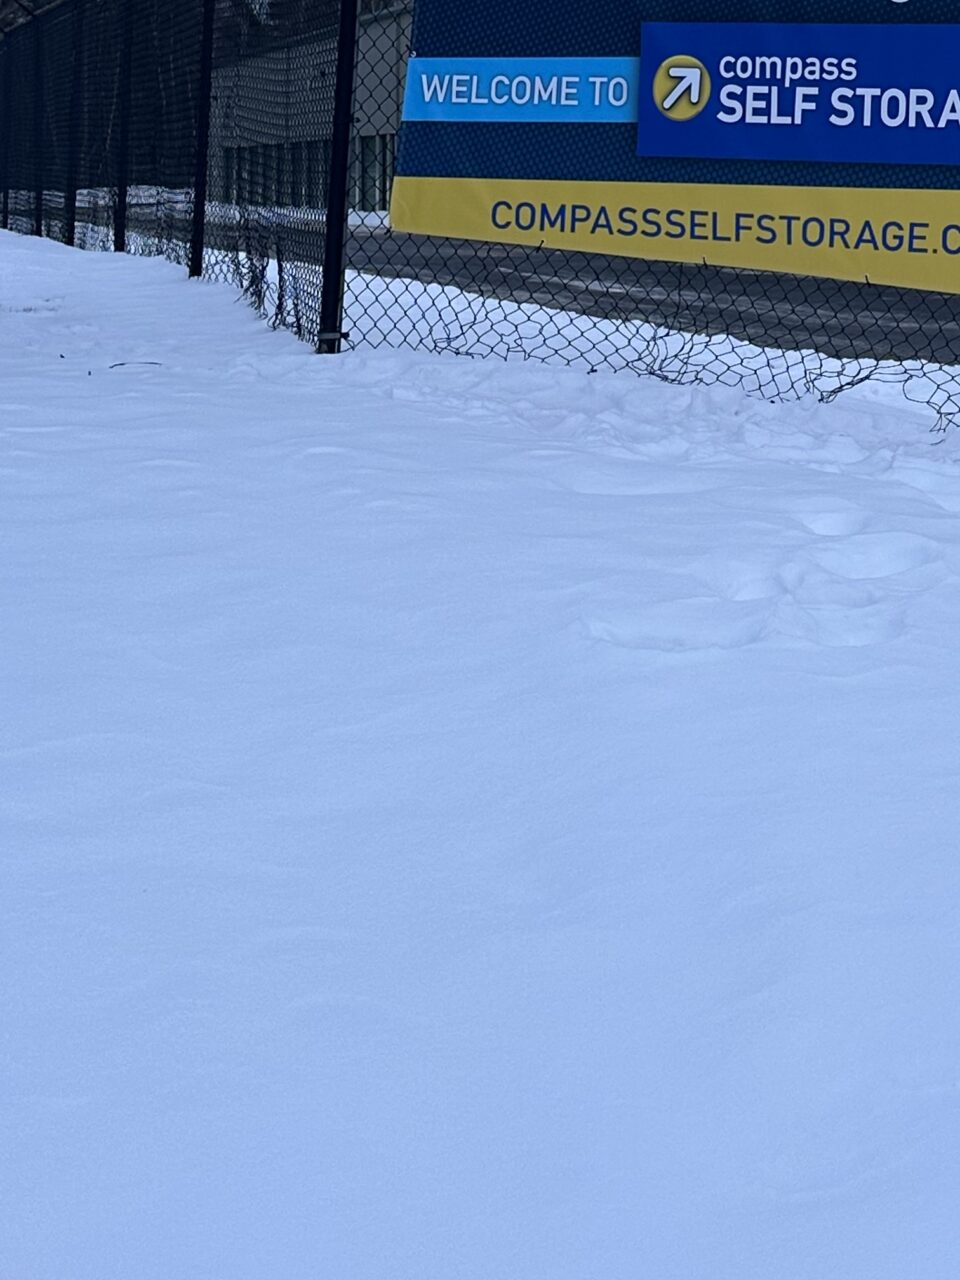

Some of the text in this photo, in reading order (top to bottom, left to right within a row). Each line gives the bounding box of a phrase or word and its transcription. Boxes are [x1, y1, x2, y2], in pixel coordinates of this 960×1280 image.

[718, 55, 858, 88] compass
[421, 73, 629, 108] WELCOME TO
[716, 83, 818, 126] SELF
